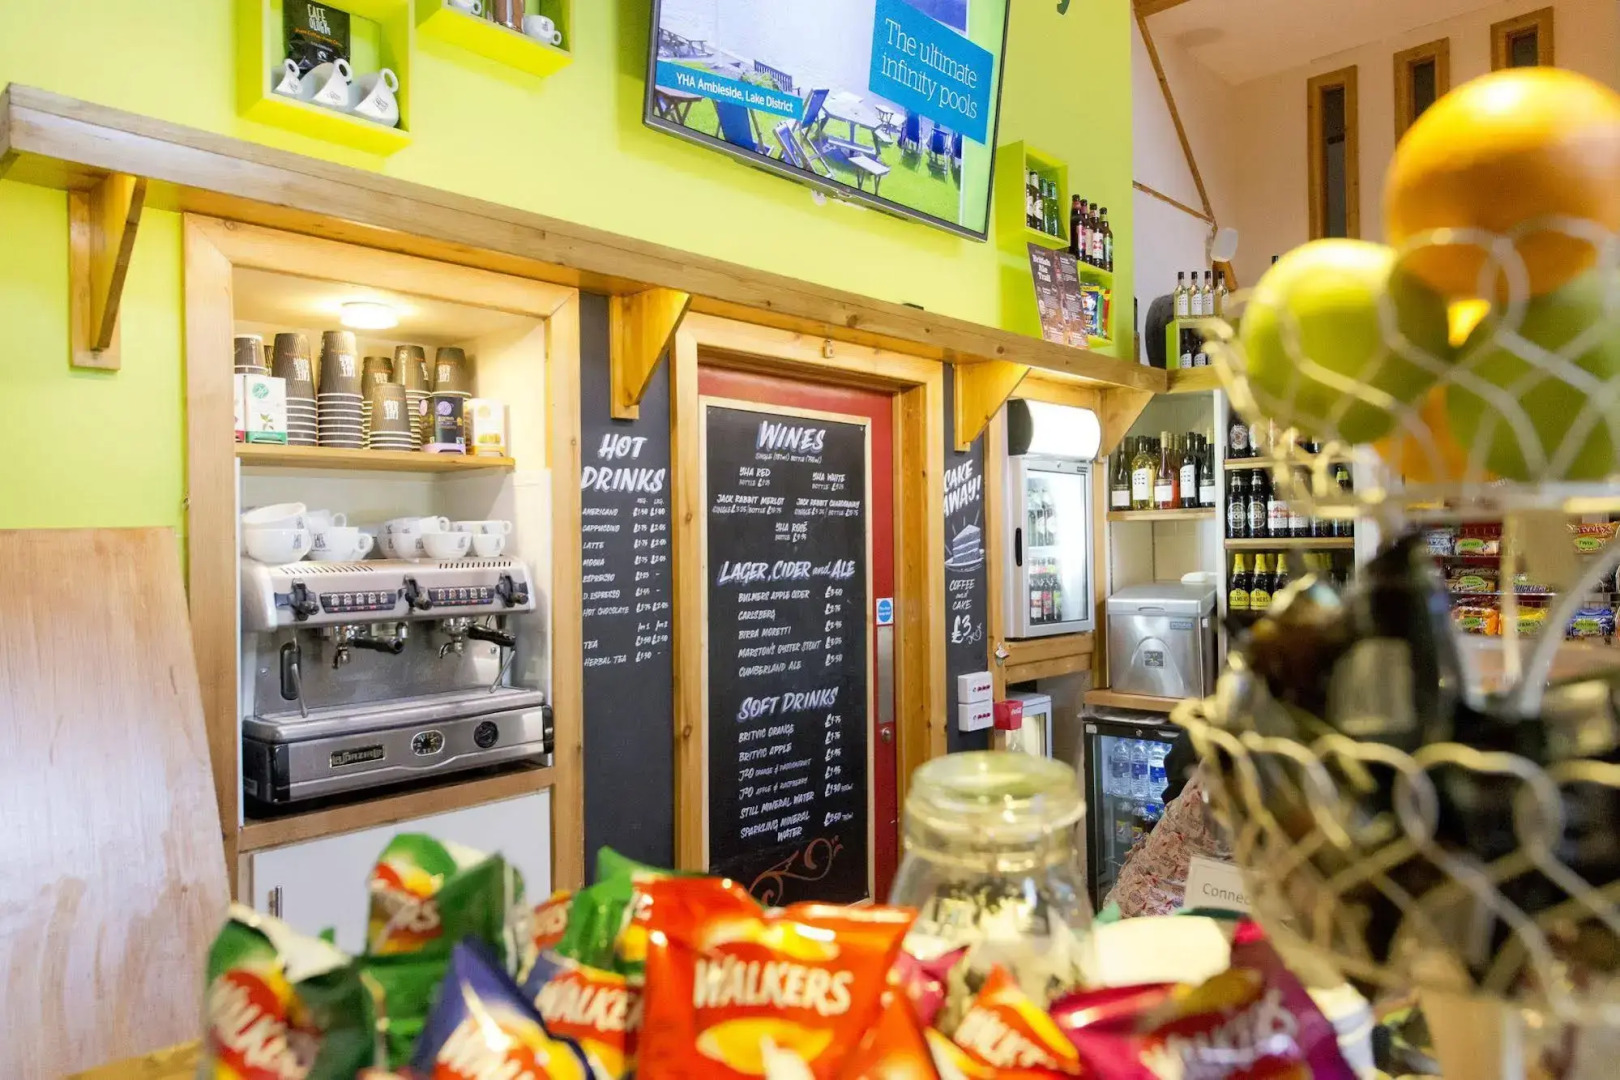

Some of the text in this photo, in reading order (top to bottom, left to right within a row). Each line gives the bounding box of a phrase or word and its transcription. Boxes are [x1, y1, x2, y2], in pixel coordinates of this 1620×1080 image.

[307, 3, 326, 20] CAFE
[885, 17, 977, 88] The ultimate
[676, 72, 794, 113] YHA Ambleside, Lake District
[881, 52, 977, 119] infinity pools
[756, 420, 827, 454] WINES
[597, 433, 648, 459] HOT
[581, 466, 666, 493] DRINKS
[756, 467, 771, 477] RED
[944, 459, 974, 492] CAKE
[716, 494, 785, 506] JACK RABBIT MERLOT
[944, 474, 982, 518] AWAY!
[582, 507, 619, 517] AMERICANO
[582, 541, 604, 549] LATTE
[772, 560, 812, 580] CIDER
[812, 562, 831, 576] and
[829, 559, 855, 580] ALE
[949, 578, 976, 591] COFFEE
[738, 591, 770, 602] BULMERS
[770, 591, 790, 600] APPLE
[791, 590, 811, 599] CIDER
[955, 589, 969, 599] and
[582, 608, 596, 617] HOT
[597, 606, 629, 616] CHOCOLATE
[952, 599, 973, 610] CAKE
[737, 609, 776, 621] CARLSBERG
[738, 628, 760, 640] BIRRA
[761, 626, 792, 637] MORETTI
[951, 614, 972, 643] £3
[583, 639, 599, 649] TEA
[777, 643, 801, 654] OYSTER
[801, 640, 822, 651] STOUT
[584, 657, 611, 667] HERBAL
[613, 654, 627, 664] TEA
[738, 663, 786, 677] CUMBERLAND
[788, 661, 802, 670] ALE
[737, 686, 839, 722] SOFT DRINKS
[738, 728, 767, 743] BRITVIC
[767, 724, 795, 737] ORANGE
[738, 748, 767, 762] BRITVIC
[769, 743, 792, 756] APPLE
[739, 805, 759, 819] STILL
[761, 797, 792, 813] MINERAL
[793, 791, 815, 804] WATER
[740, 819, 779, 839] SPARKLING
[780, 811, 811, 827] MINERAL
[777, 826, 803, 842] WATER
[693, 953, 854, 1016] WALKERS
